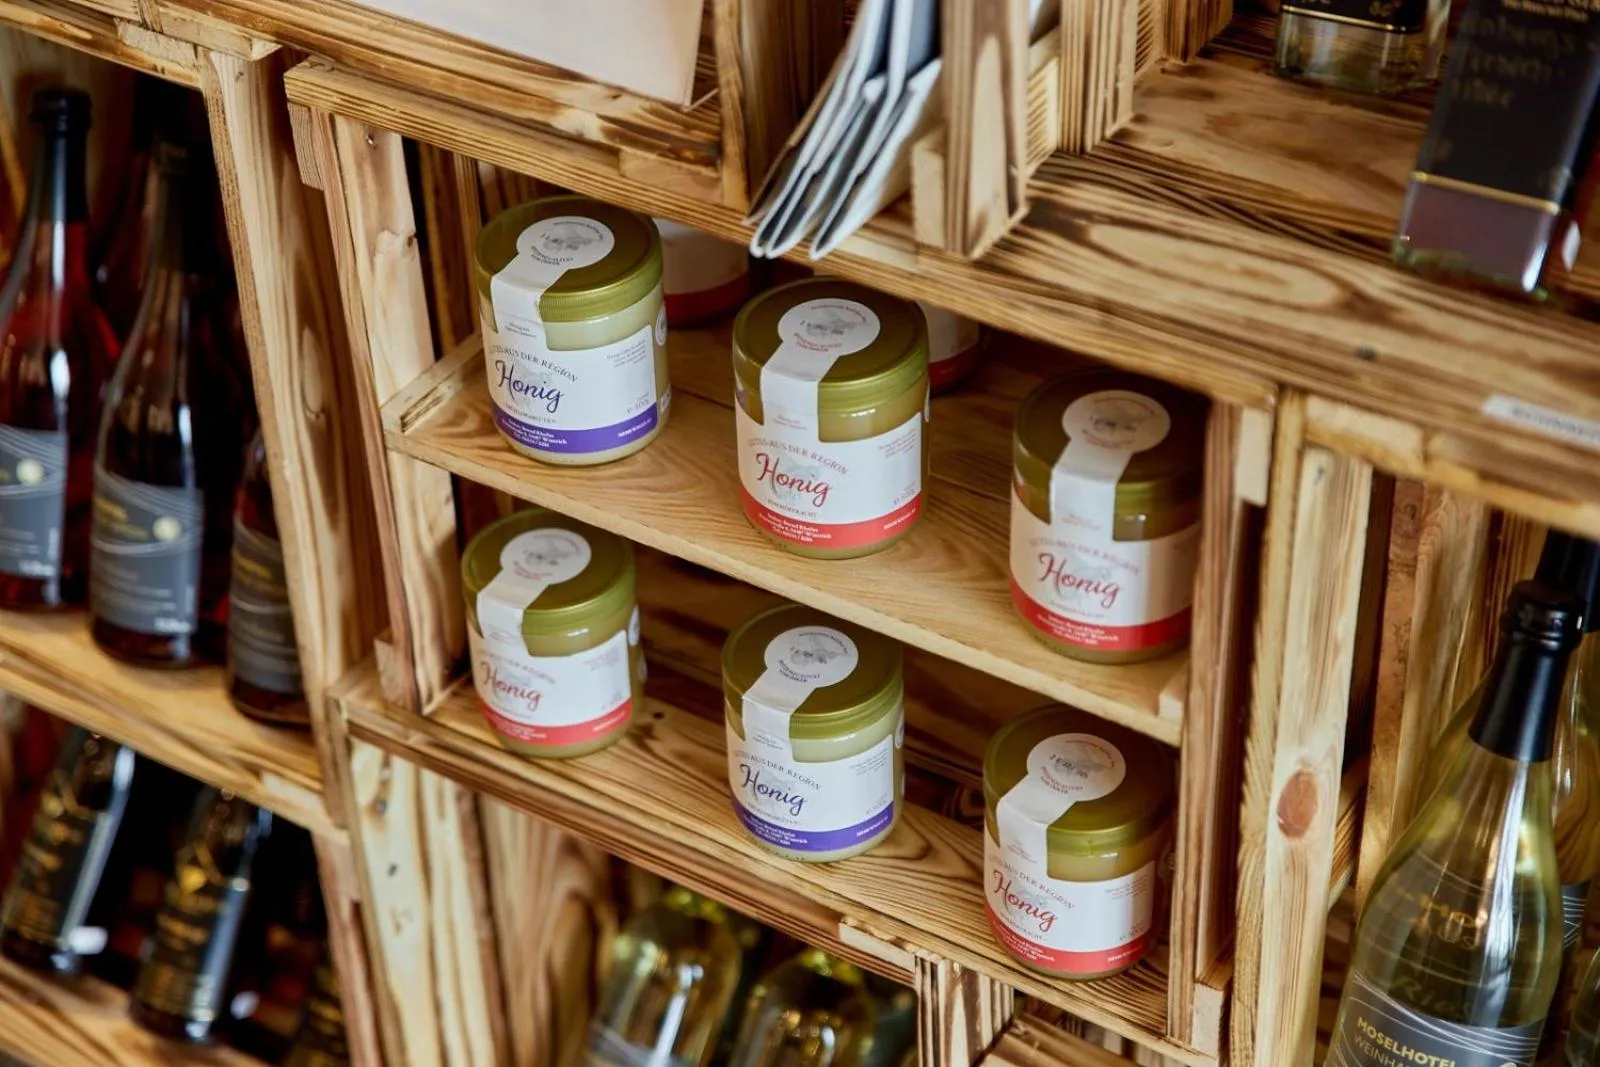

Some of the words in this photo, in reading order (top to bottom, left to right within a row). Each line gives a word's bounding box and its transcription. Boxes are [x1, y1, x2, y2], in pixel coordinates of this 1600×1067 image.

[495, 360, 565, 413] Honig
[521, 352, 539, 364] DER
[541, 359, 578, 382] REGION
[756, 452, 832, 507] Honig
[788, 443, 809, 457] DER
[811, 450, 849, 475] REGION
[1038, 552, 1121, 608] Honig
[481, 661, 542, 711] Honig
[740, 764, 807, 816] Honig
[767, 761, 785, 772] DER
[787, 768, 822, 791] REGION
[993, 869, 1058, 932] Honig
[1019, 872, 1039, 887] DER
[1040, 883, 1075, 910] REGION
[1354, 1034, 1410, 1067] WEINH
